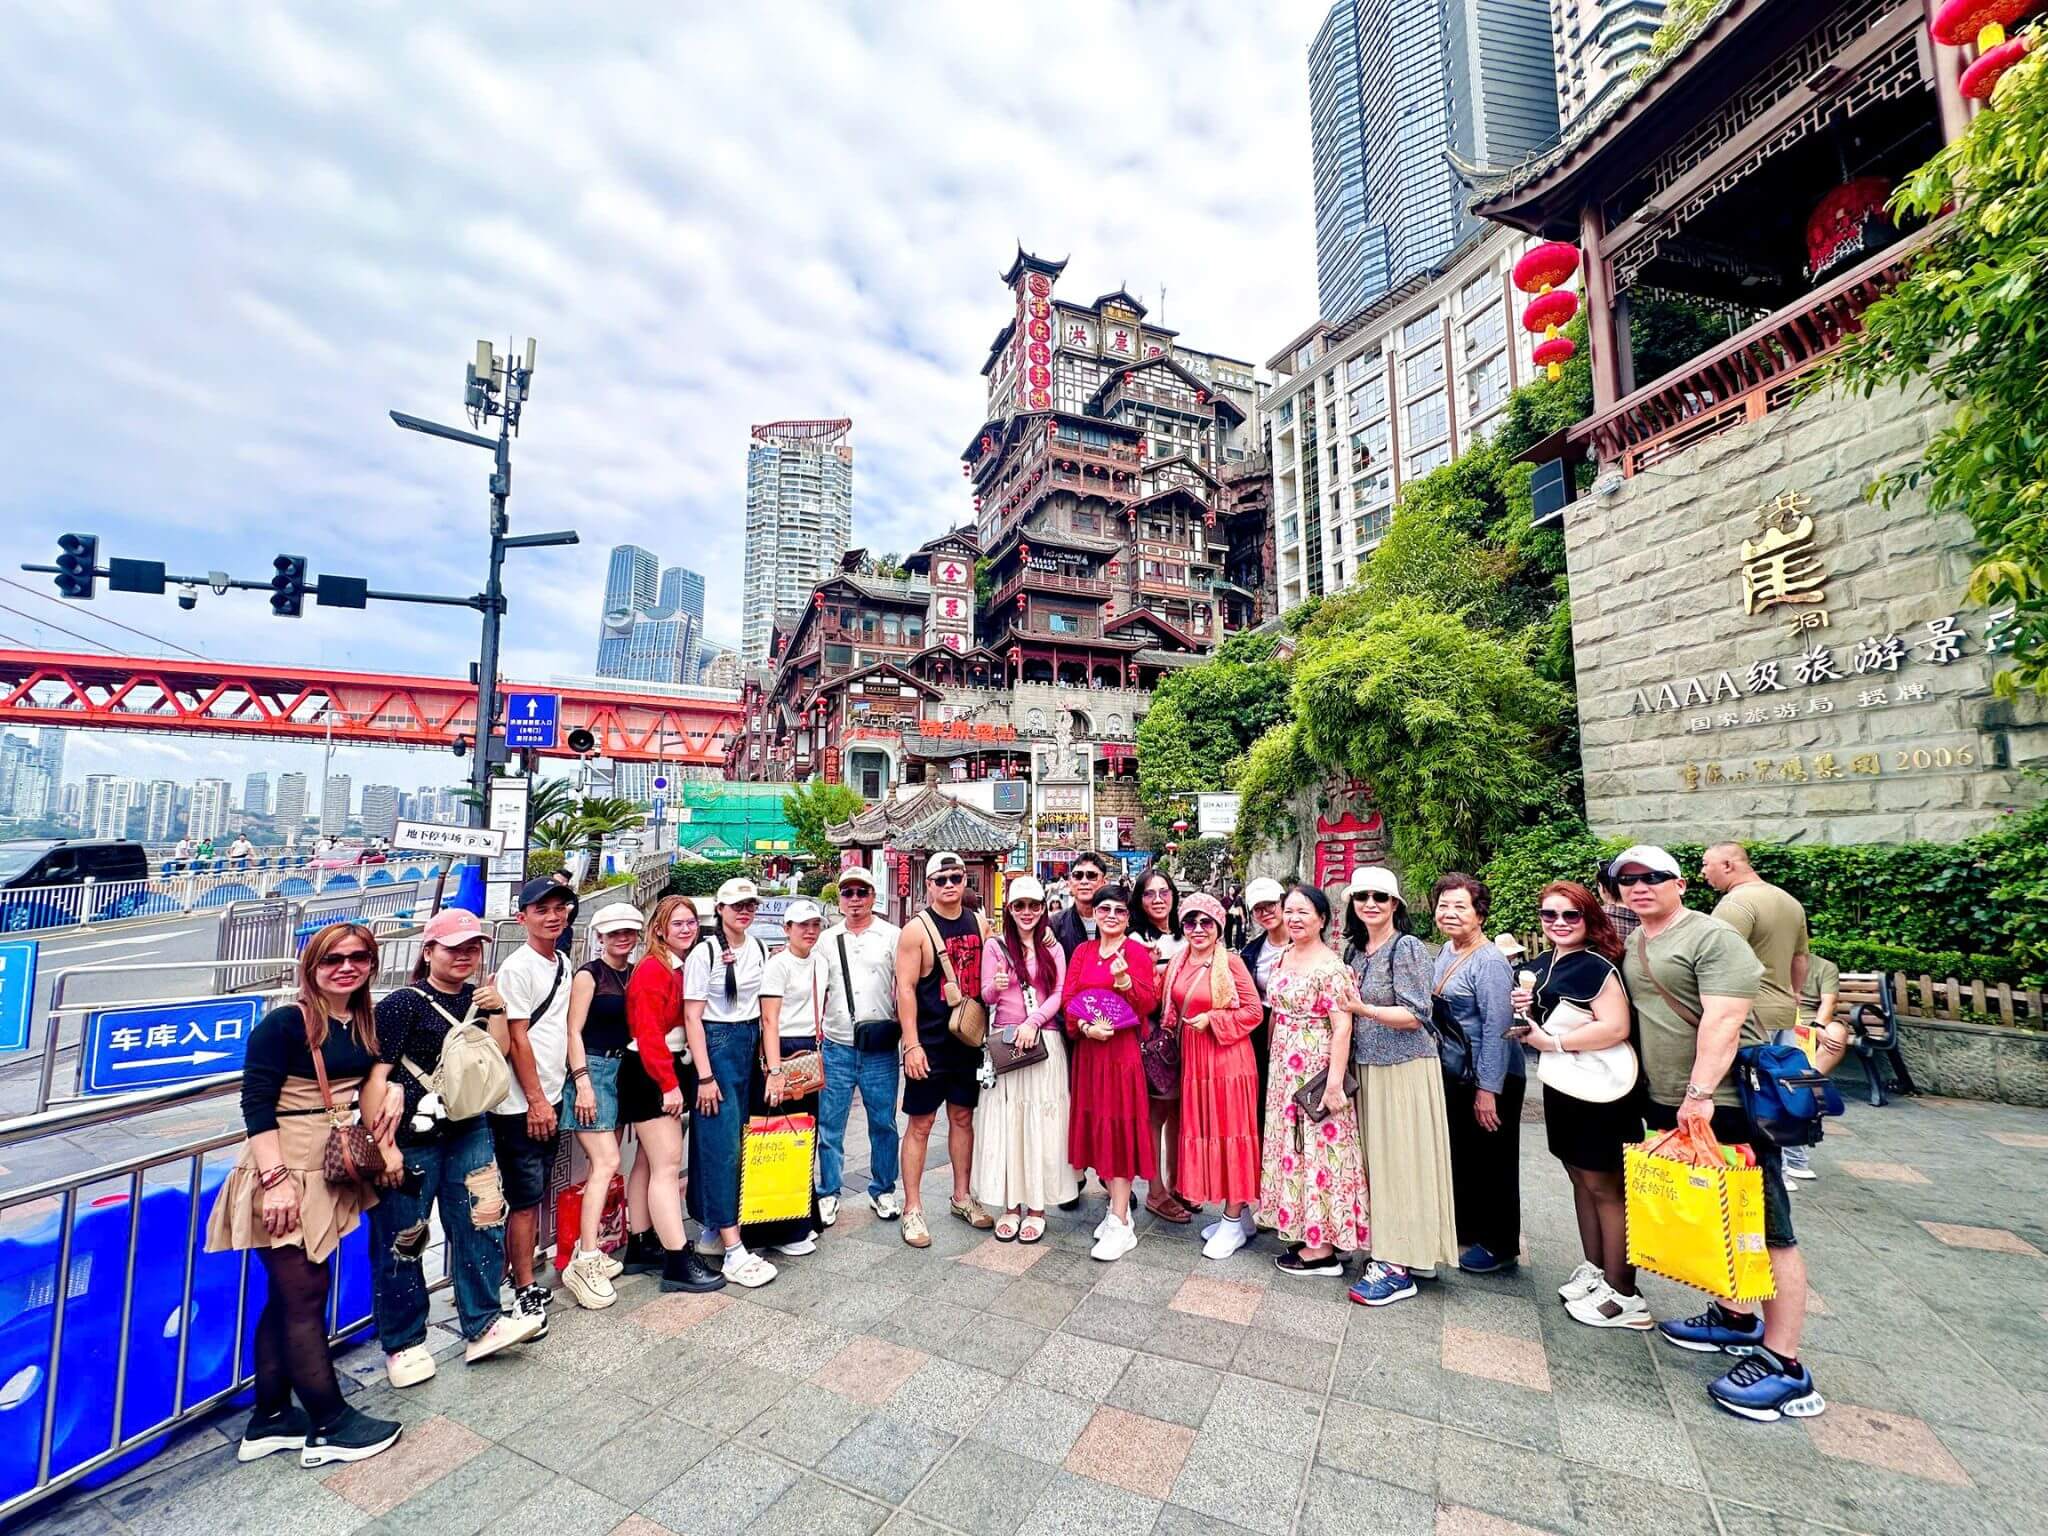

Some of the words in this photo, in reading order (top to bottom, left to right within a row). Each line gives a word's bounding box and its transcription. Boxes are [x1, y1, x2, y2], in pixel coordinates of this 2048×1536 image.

[1741, 489, 1829, 638] 洪崖洞
[1690, 696, 1834, 732] 国家旅游局
[1857, 682, 1929, 707] 授牌
[1895, 743, 1975, 771] 2006
[406, 828, 462, 844] 地下停车场
[109, 1018, 243, 1051] 车库入口
